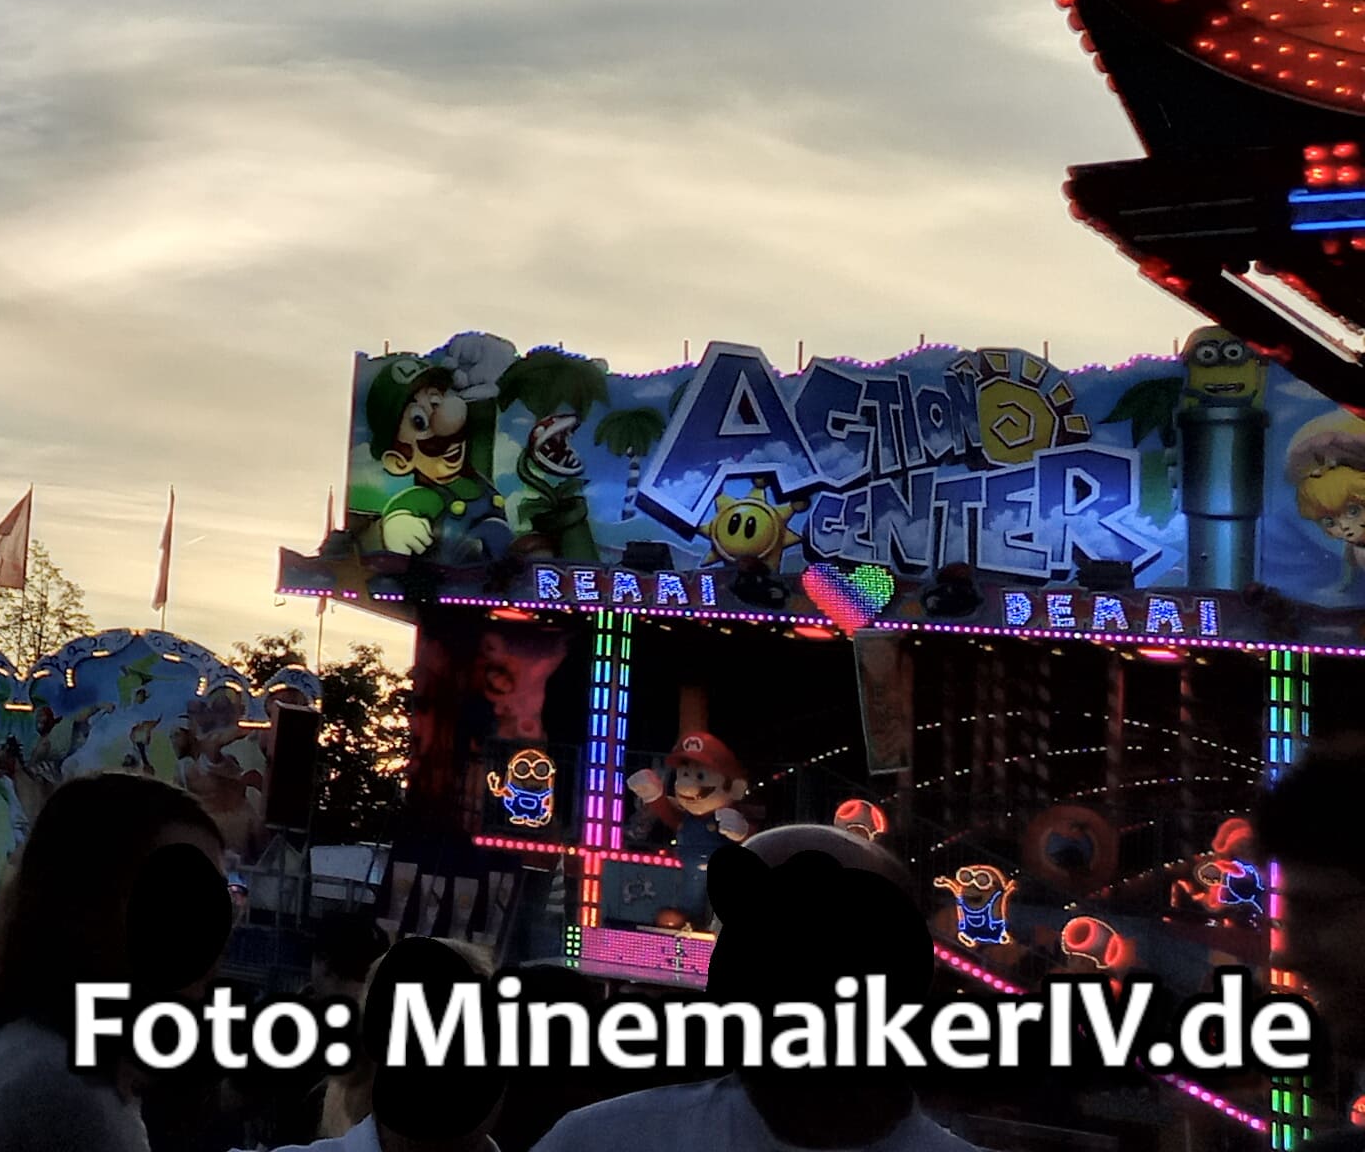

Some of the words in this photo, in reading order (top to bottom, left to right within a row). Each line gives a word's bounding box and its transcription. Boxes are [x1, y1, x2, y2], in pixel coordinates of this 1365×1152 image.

[637, 342, 981, 530] ACTION
[806, 450, 1163, 580] CENTER
[535, 567, 717, 607] REMMI
[1004, 592, 1218, 637] DEMMI
